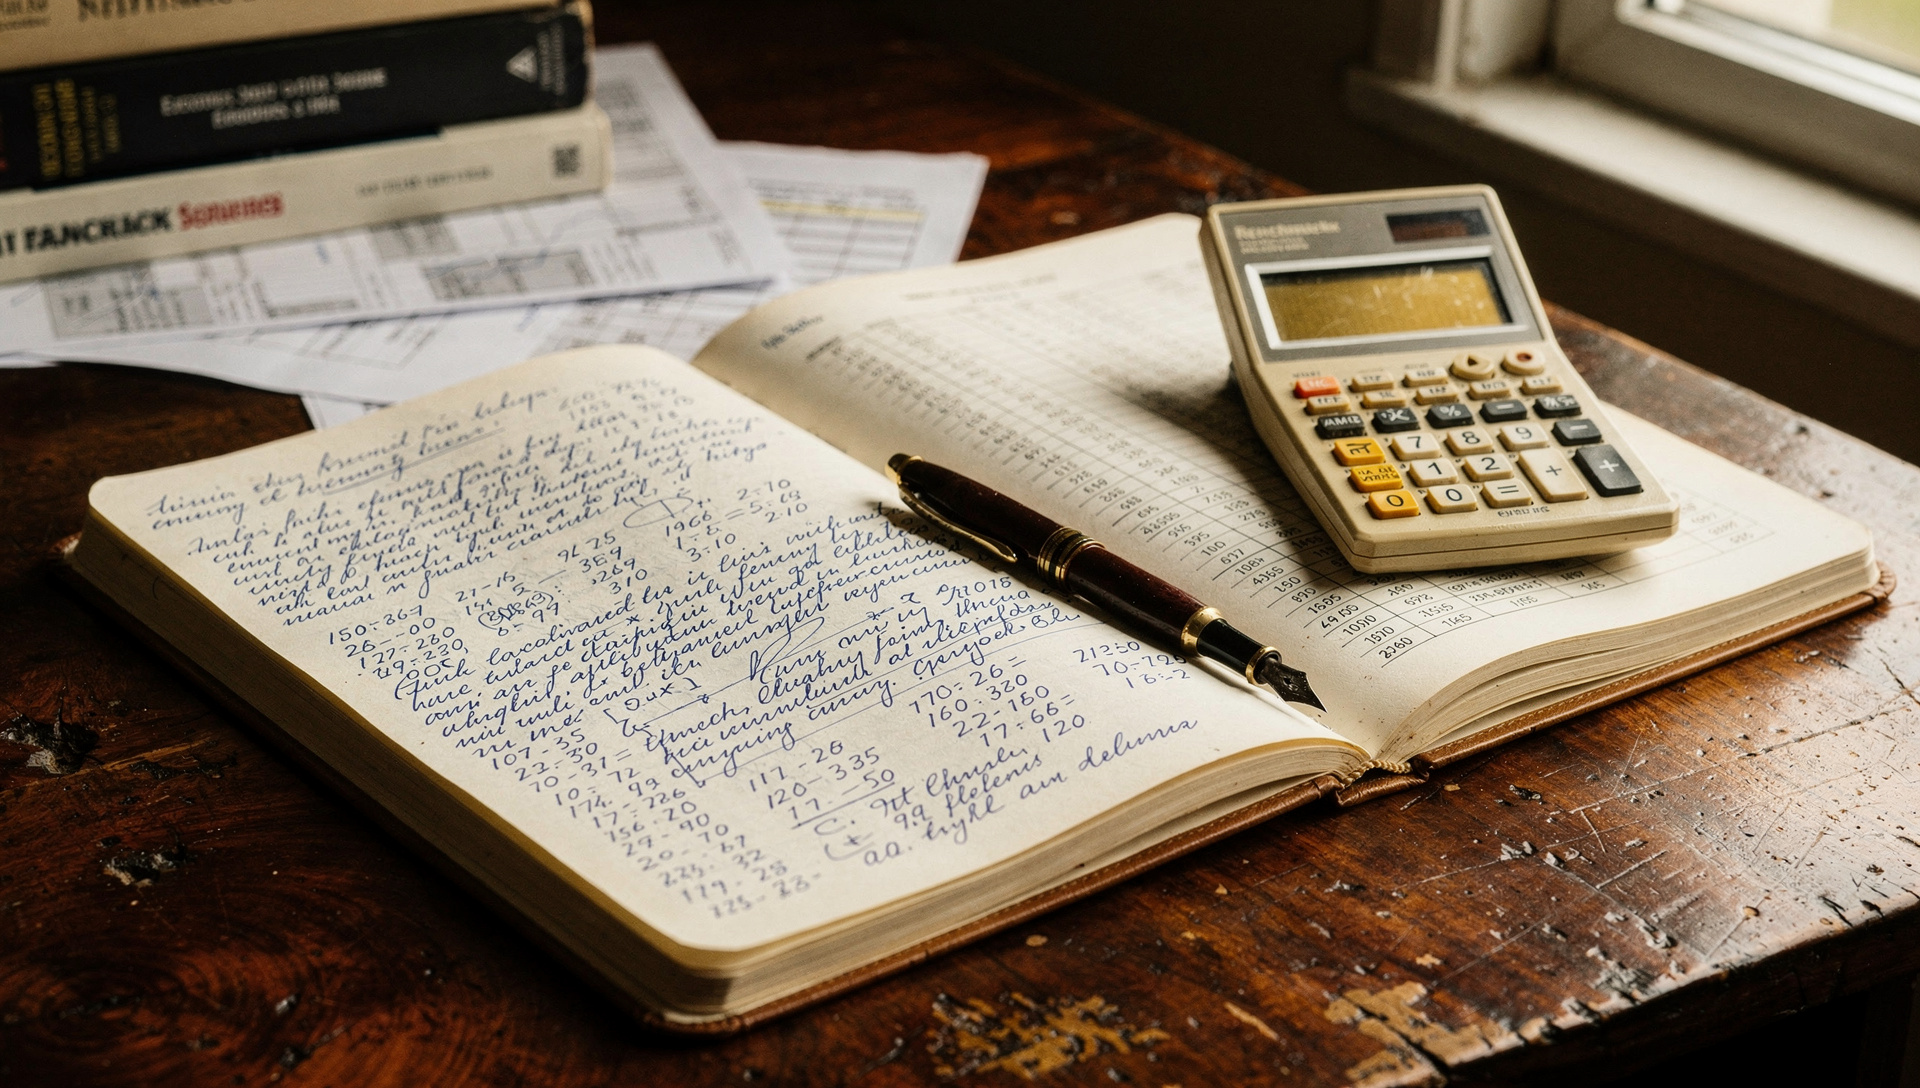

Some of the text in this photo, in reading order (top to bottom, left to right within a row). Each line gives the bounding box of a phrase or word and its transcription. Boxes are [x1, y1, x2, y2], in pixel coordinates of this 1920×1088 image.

[1407, 435, 1422, 448] 7
[1461, 431, 1481, 445] 8
[1515, 427, 1532, 440] 9
[1428, 462, 1443, 475] 1
[1481, 457, 1501, 471] 2
[1386, 494, 1405, 507] 0
[1445, 489, 1463, 502] 0
